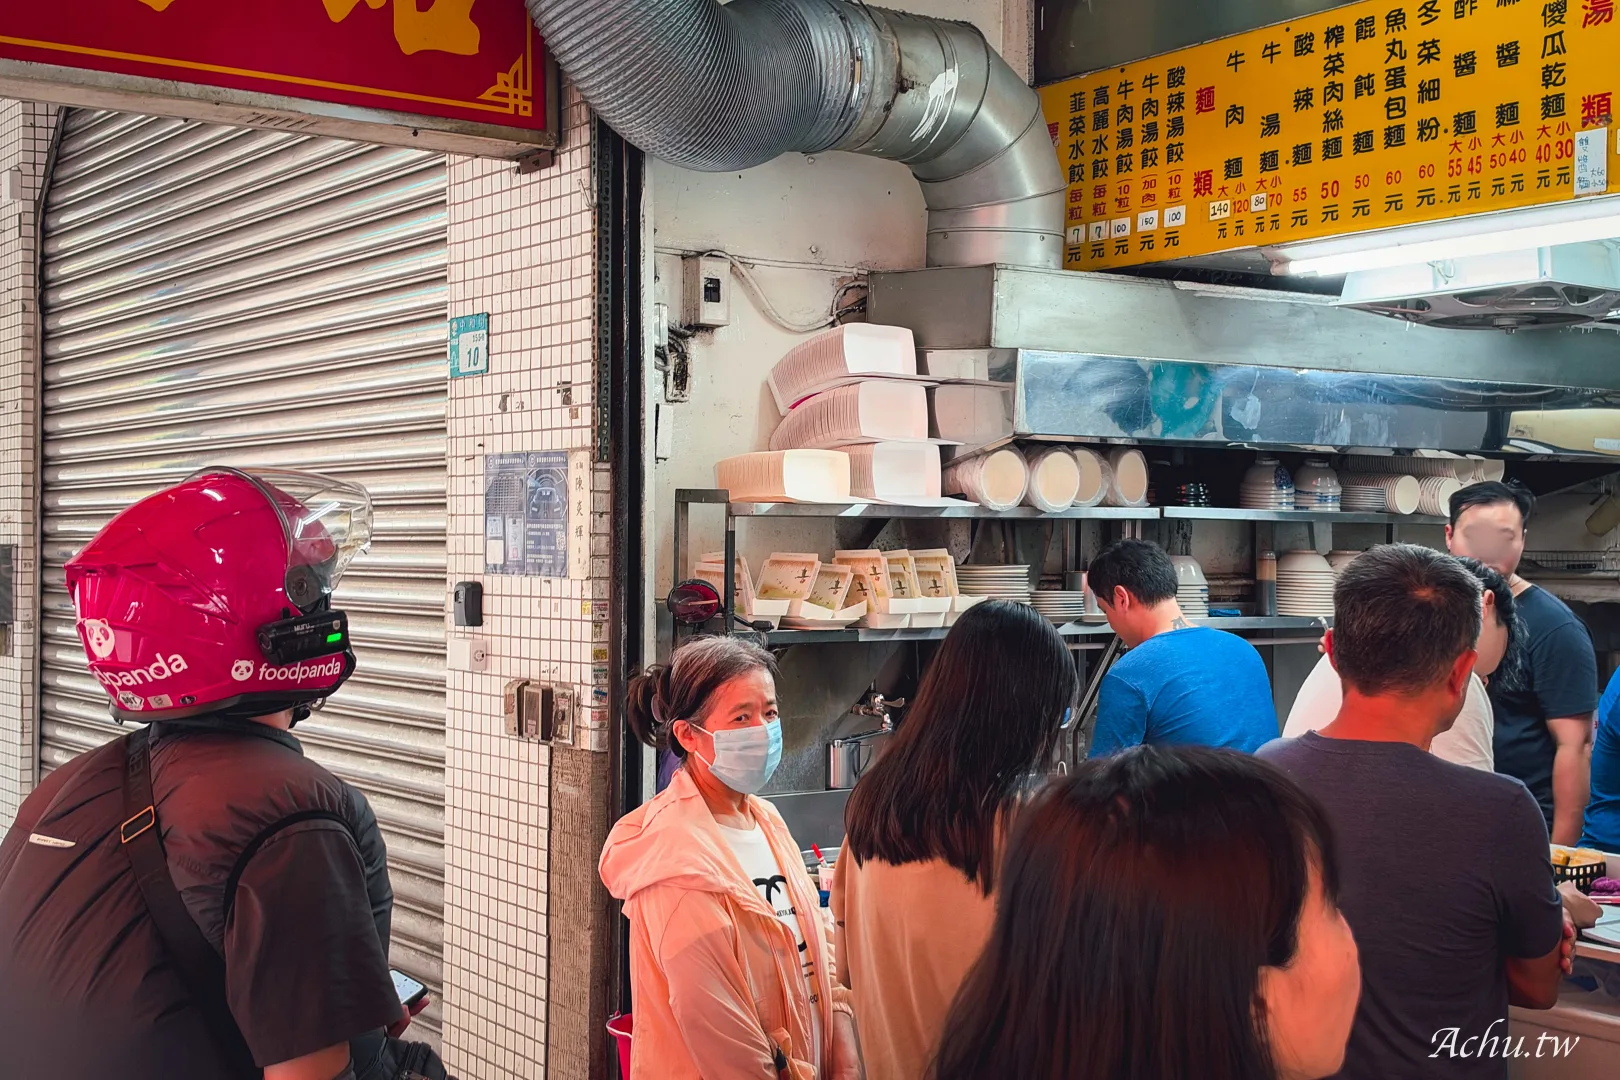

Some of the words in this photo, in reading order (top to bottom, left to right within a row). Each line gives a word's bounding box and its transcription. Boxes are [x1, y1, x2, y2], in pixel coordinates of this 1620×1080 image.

[1540, 0, 1567, 121] 傻瓜乾麵
[1383, 7, 1407, 150] 魚丸蛋包麵
[1416, 0, 1441, 142] 冬菜細粉
[1321, 24, 1345, 162] 榨菜肉絲麵
[1352, 15, 1375, 156] 餛飩麵
[1292, 31, 1315, 167] 酸辣麵
[1140, 72, 1159, 170] 牛肉湯餃
[1165, 65, 1186, 165] 酸辣湯餃
[1224, 50, 1246, 181] 牛肉麵
[1091, 85, 1110, 180] 高麗水餃
[1115, 79, 1134, 176] 牛肉湯餃
[1510, 129, 1524, 144] 小
[1536, 124, 1551, 140] 大
[1556, 120, 1571, 136] 小
[1193, 85, 1215, 199] 麵類
[1449, 139, 1463, 155] 大
[1468, 136, 1482, 151] 小
[1491, 132, 1506, 148] 大
[1555, 138, 1573, 160] 30
[1489, 153, 1506, 169] 50
[1509, 148, 1526, 164] 40
[1535, 143, 1550, 164] 40
[1418, 163, 1435, 179] 60
[1448, 158, 1462, 178] 55
[1467, 155, 1482, 174] 45
[1256, 178, 1268, 191] 大
[1270, 175, 1282, 189] 小
[1354, 173, 1370, 190] 50
[1385, 169, 1402, 186] 60
[1510, 173, 1524, 193] 元
[1536, 169, 1550, 190] 元
[1556, 166, 1570, 186] 元
[1217, 185, 1229, 198] 大
[1235, 181, 1246, 195] 小
[1293, 187, 1307, 202] 55
[1321, 180, 1340, 199] 50
[1447, 184, 1461, 204] 元
[1467, 181, 1481, 200] 元
[1491, 177, 1505, 197] 元
[1068, 188, 1083, 221] 每粒
[1092, 184, 1107, 217] 每粒
[1233, 199, 1249, 214] 120
[1254, 197, 1265, 207] 80
[1269, 193, 1283, 207] 70
[1384, 193, 1403, 213] 元
[1416, 188, 1436, 208] 元
[1168, 211, 1181, 223] 100
[1210, 205, 1229, 217] 140
[1321, 204, 1339, 223] 元
[1352, 199, 1370, 218] 元
[1141, 217, 1155, 227] 150
[1255, 216, 1265, 234] 元
[1270, 213, 1280, 231] 元
[1291, 209, 1308, 228] 元
[1114, 223, 1127, 234] 100
[1217, 222, 1227, 240] 元
[1234, 219, 1244, 237] 元
[1114, 238, 1129, 256] 元
[1139, 234, 1154, 251] 元
[1164, 230, 1180, 248] 元
[1067, 246, 1081, 263] 元
[1090, 242, 1105, 260] 元
[467, 347, 479, 367] 10
[258, 657, 341, 683] foodpanda
